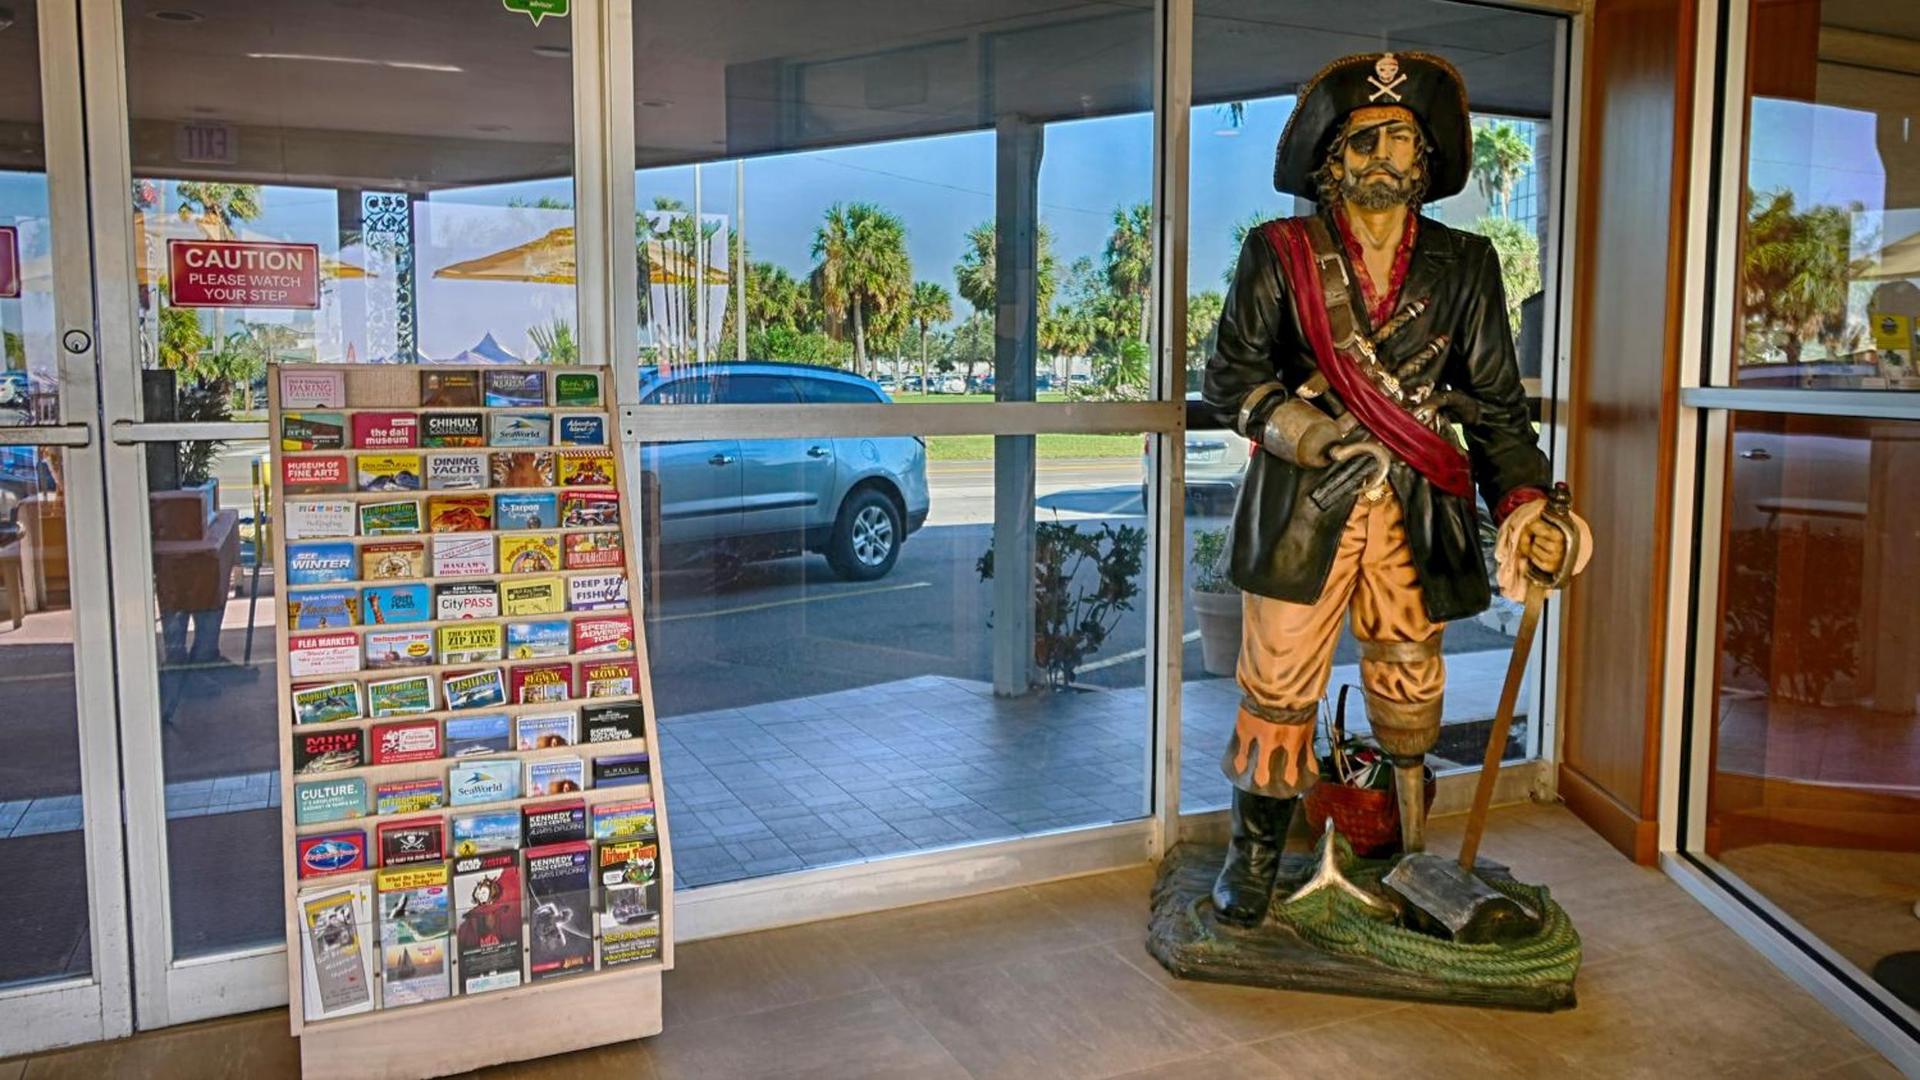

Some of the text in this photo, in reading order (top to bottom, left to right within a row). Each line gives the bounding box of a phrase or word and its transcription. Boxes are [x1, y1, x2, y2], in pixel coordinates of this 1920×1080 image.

[185, 248, 303, 270] CAUTION
[189, 273, 301, 288] PLEASE WATCH
[204, 288, 288, 301] YOUR STEP
[289, 384, 332, 392] DARING
[429, 418, 478, 428] CHIHULY
[370, 427, 408, 436] the dali
[429, 427, 478, 435] COLLECTION
[500, 430, 541, 439] SeaWorld
[365, 436, 409, 445] museum
[433, 457, 478, 466] DINING
[288, 469, 340, 478] FINE ARTS
[432, 465, 480, 474] YACHTS
[511, 504, 540, 512] Tarpon
[292, 558, 351, 570] WINTER
[573, 577, 624, 588] DEEP SEA
[577, 588, 621, 600] FISHING
[442, 598, 493, 611] CityPASS
[298, 636, 355, 648] FLEA MARKETS
[373, 635, 409, 643] Helicopter
[448, 637, 466, 646] ZIP
[470, 634, 497, 644] LINE
[524, 672, 562, 683] SEGWAY
[589, 667, 629, 679] SEGWAY
[450, 673, 496, 692] FISHING
[306, 733, 357, 745] MINI
[306, 742, 356, 754] GOLF
[301, 784, 358, 800] CULTURE.
[458, 783, 502, 796] SeaWorld
[529, 811, 571, 822] KENNEDY
[548, 818, 571, 826] CENTER
[459, 858, 480, 866] STAR
[530, 855, 573, 866] KENNEDY
[456, 863, 482, 872] WARS
[413, 878, 434, 886] Today?
